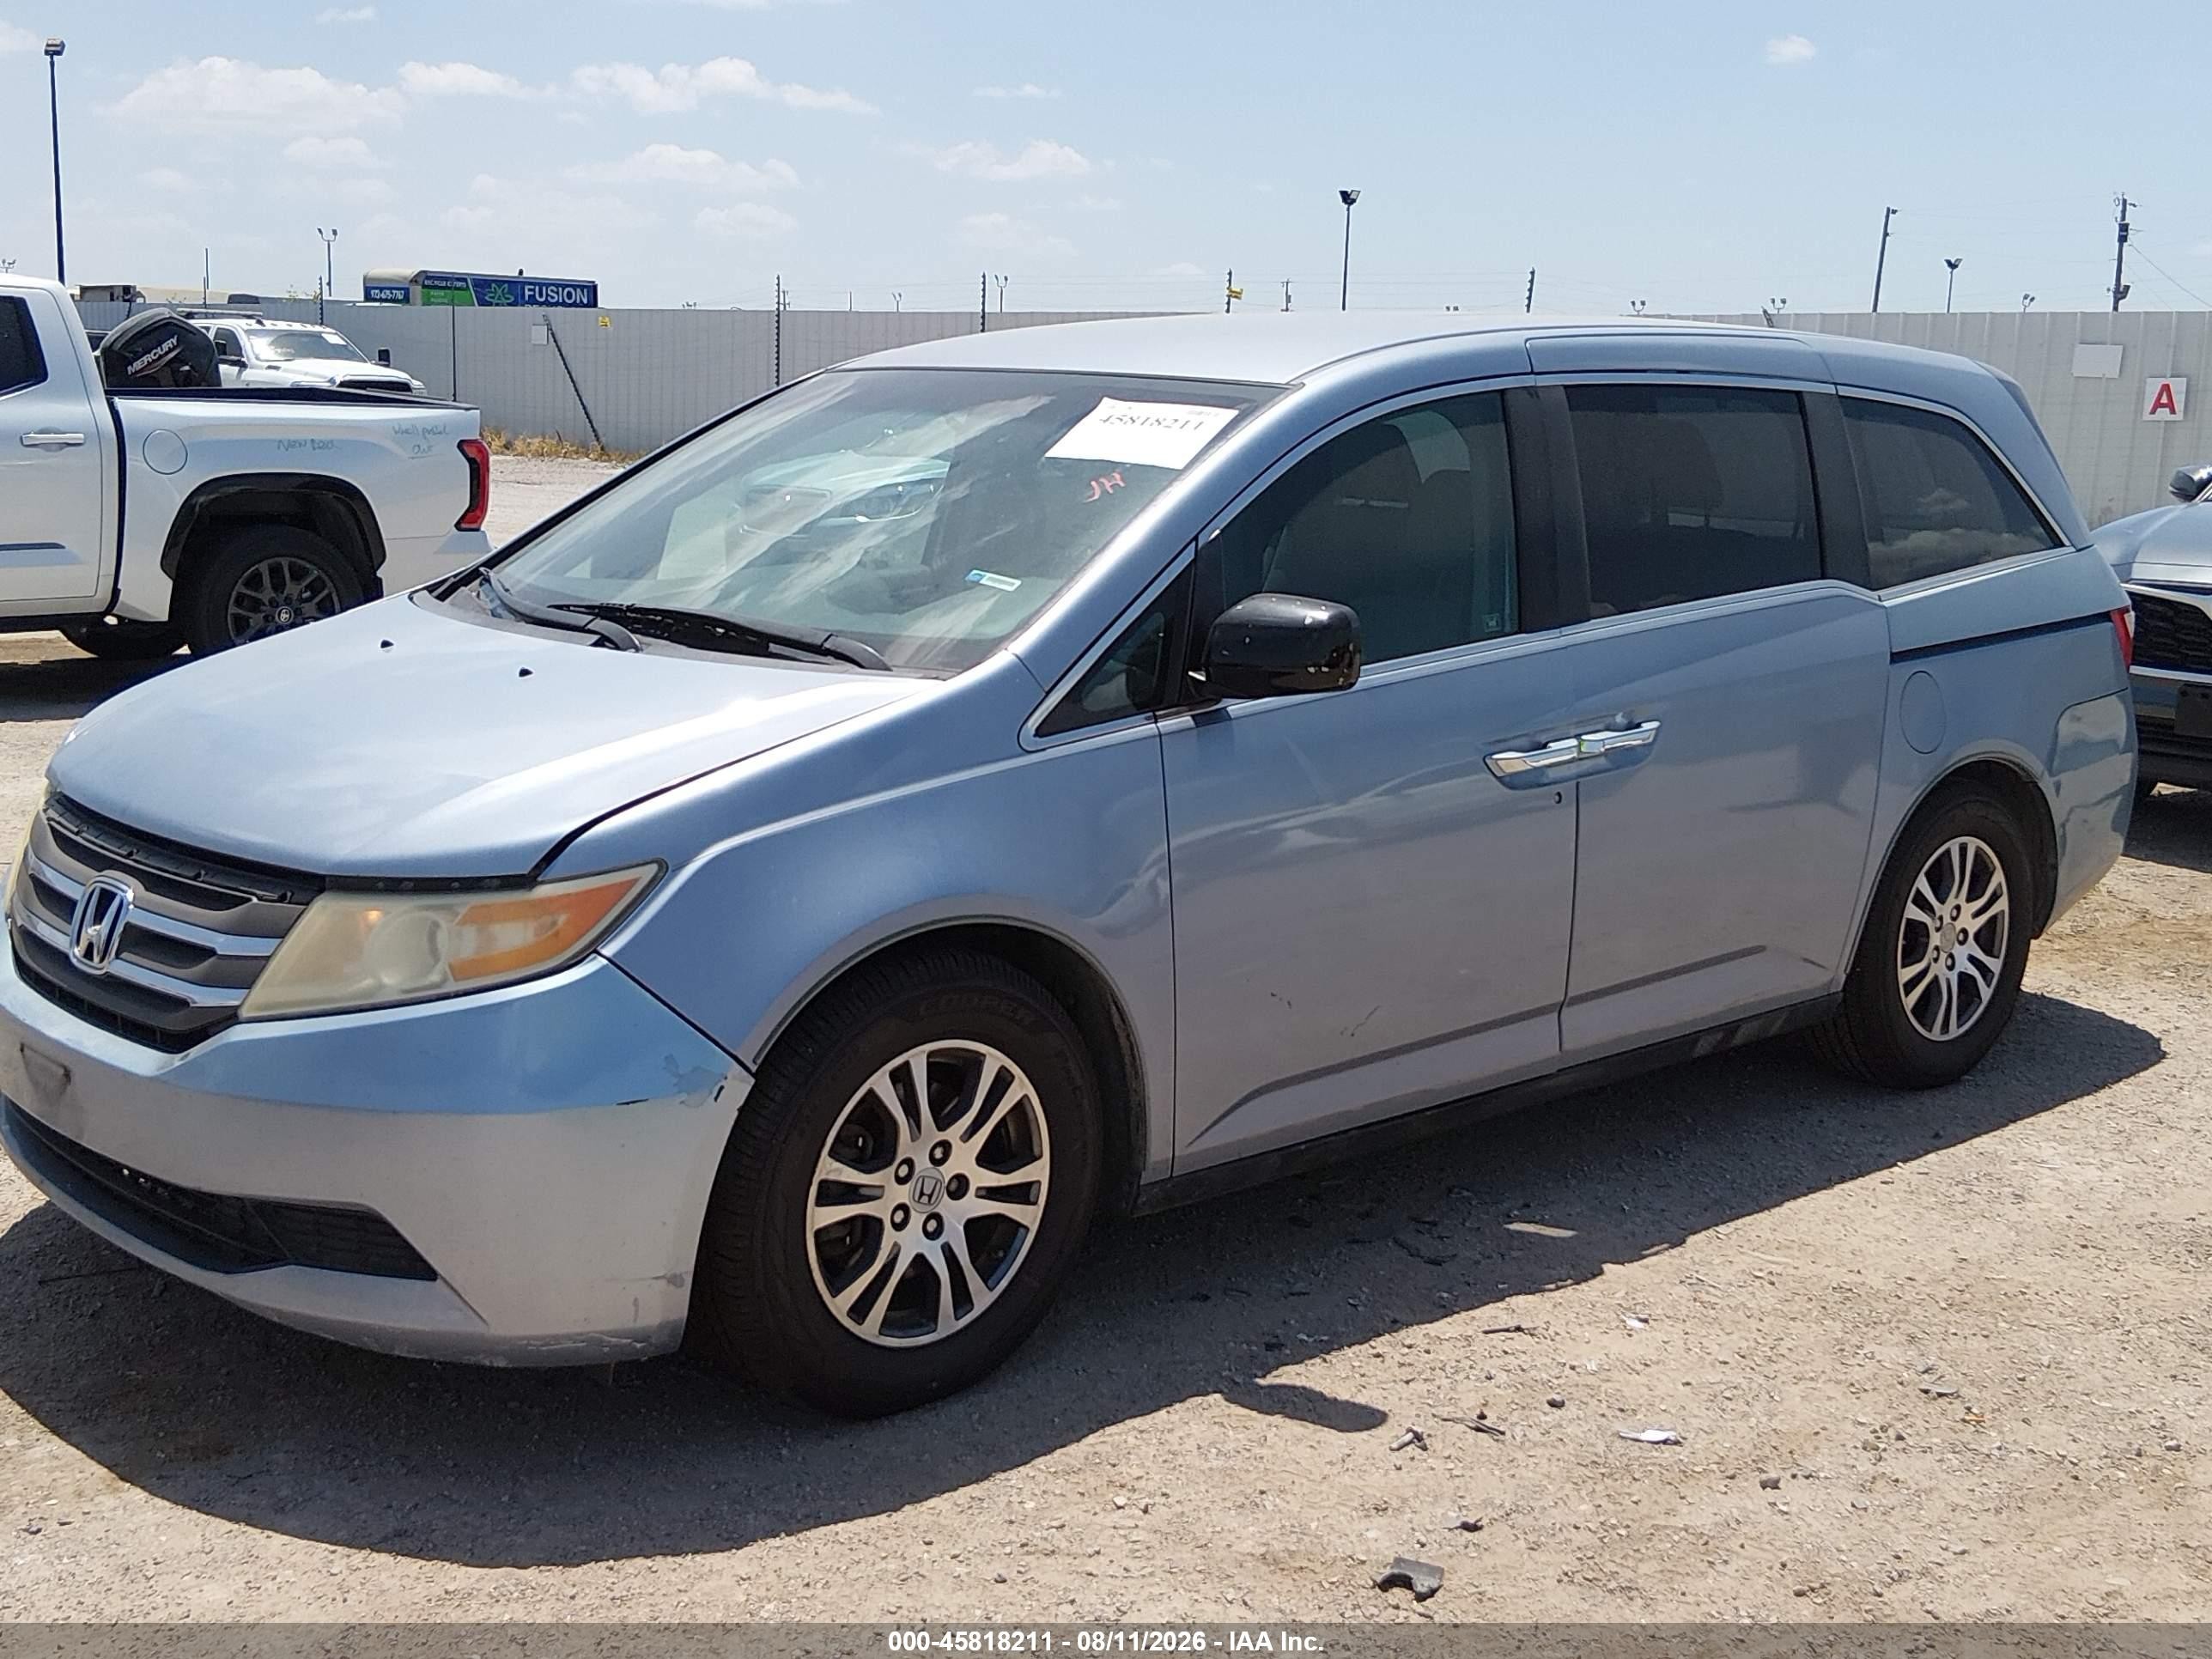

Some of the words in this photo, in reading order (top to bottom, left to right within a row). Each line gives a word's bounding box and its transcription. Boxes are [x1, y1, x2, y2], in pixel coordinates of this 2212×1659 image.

[524, 285, 588, 304] FUSION
[126, 334, 179, 375] MERCURY
[2148, 383, 2177, 415] A
[1099, 413, 1205, 431] 45818211
